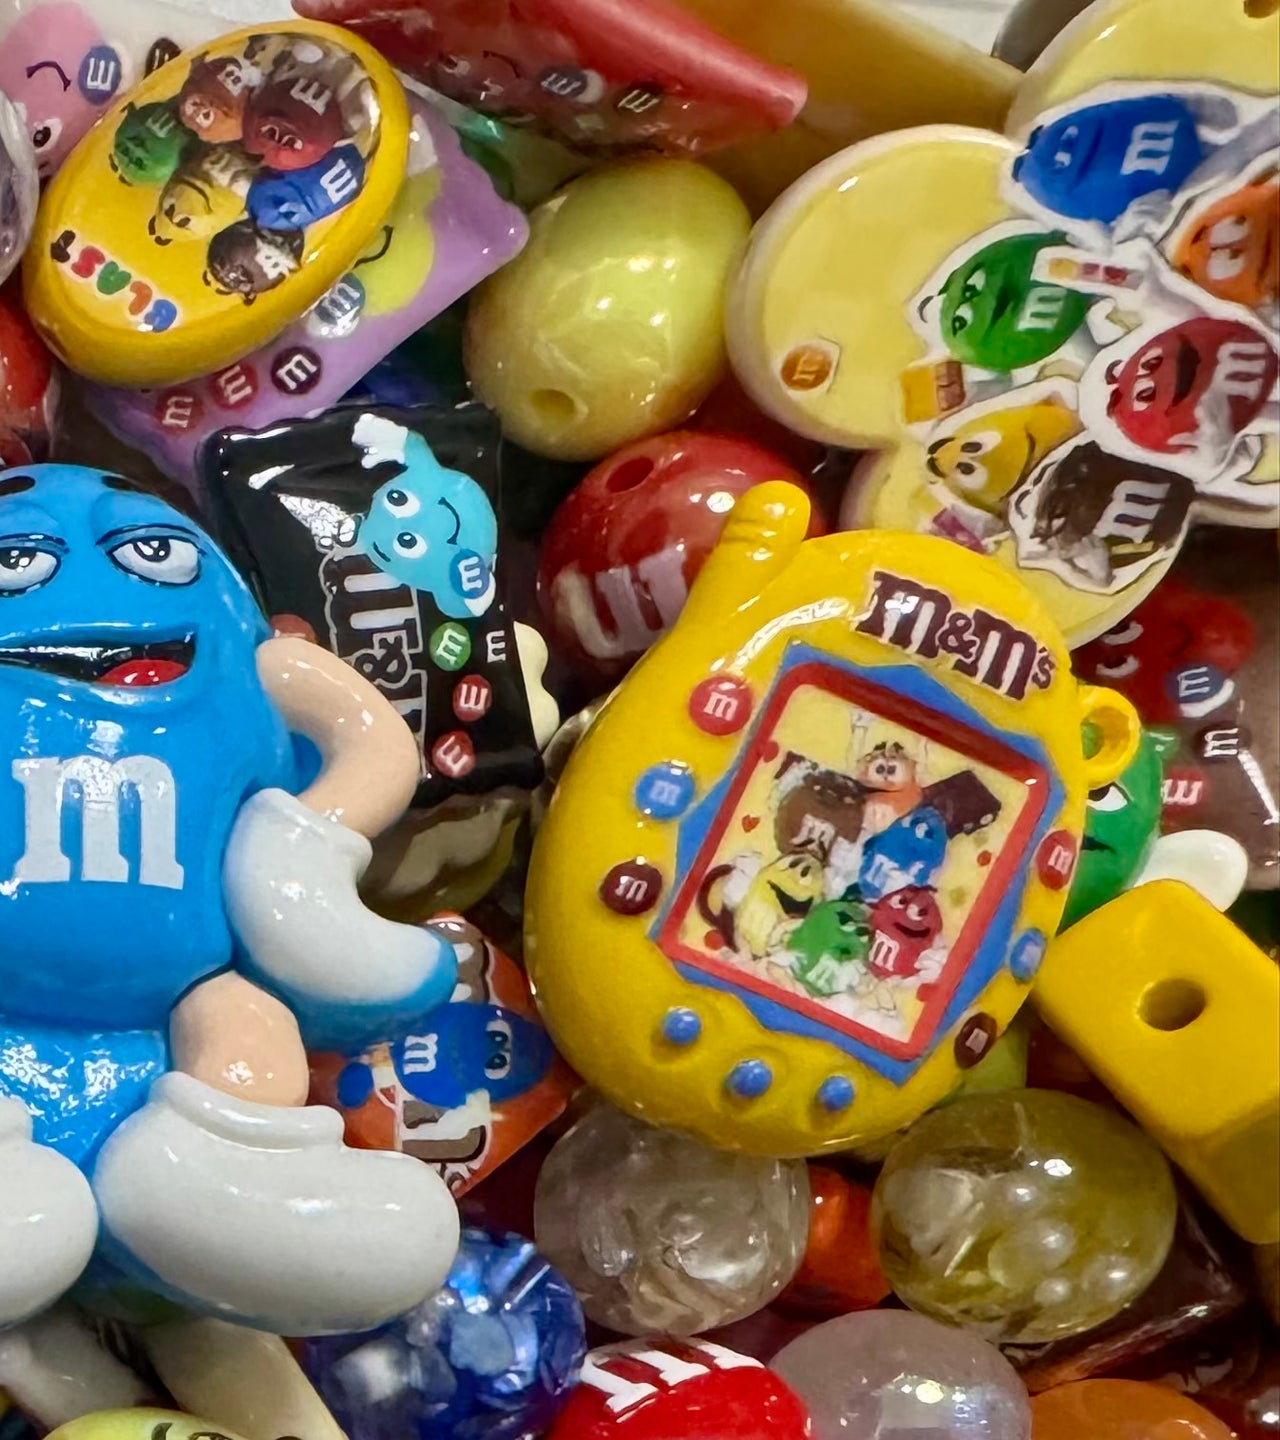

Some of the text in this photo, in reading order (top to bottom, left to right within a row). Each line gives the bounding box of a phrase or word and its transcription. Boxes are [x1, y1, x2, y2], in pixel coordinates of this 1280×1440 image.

[86, 56, 116, 89] m
[290, 77, 332, 115] m
[1121, 121, 1179, 175] m
[320, 159, 356, 202] m
[1017, 287, 1067, 330] m
[223, 368, 252, 404] m
[278, 355, 316, 388] m
[162, 394, 192, 429] m
[1093, 480, 1173, 544] m
[458, 557, 482, 592] m
[437, 629, 466, 665] m
[487, 630, 506, 663] m
[855, 571, 1057, 701] m&m's
[460, 684, 489, 710] m
[1178, 666, 1210, 697] m
[704, 692, 739, 721] m
[440, 738, 469, 771] m
[1204, 728, 1239, 757] m
[650, 778, 681, 805] m
[12, 755, 184, 889] m
[616, 876, 649, 903] m
[869, 930, 899, 971] m
[404, 1033, 438, 1075] m
